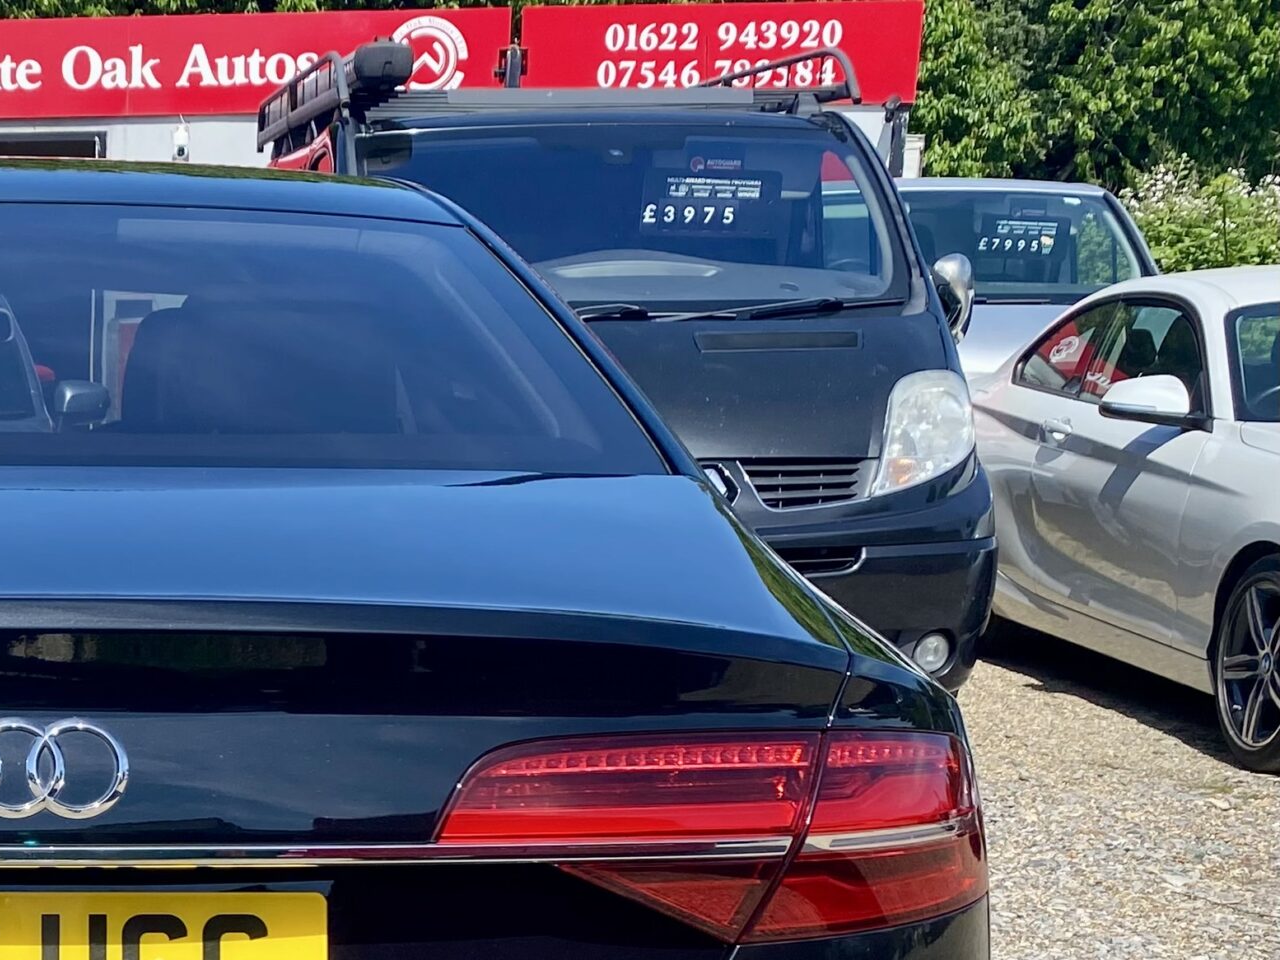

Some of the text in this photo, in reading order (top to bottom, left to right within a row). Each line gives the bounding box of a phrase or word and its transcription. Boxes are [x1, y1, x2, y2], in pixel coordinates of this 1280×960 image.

[604, 19, 843, 52] 01622 943920
[61, 43, 162, 90] Oak
[175, 43, 320, 87] Autos
[596, 59, 701, 89] 07546
[642, 203, 735, 225] £3975
[978, 236, 1039, 252] £7995
